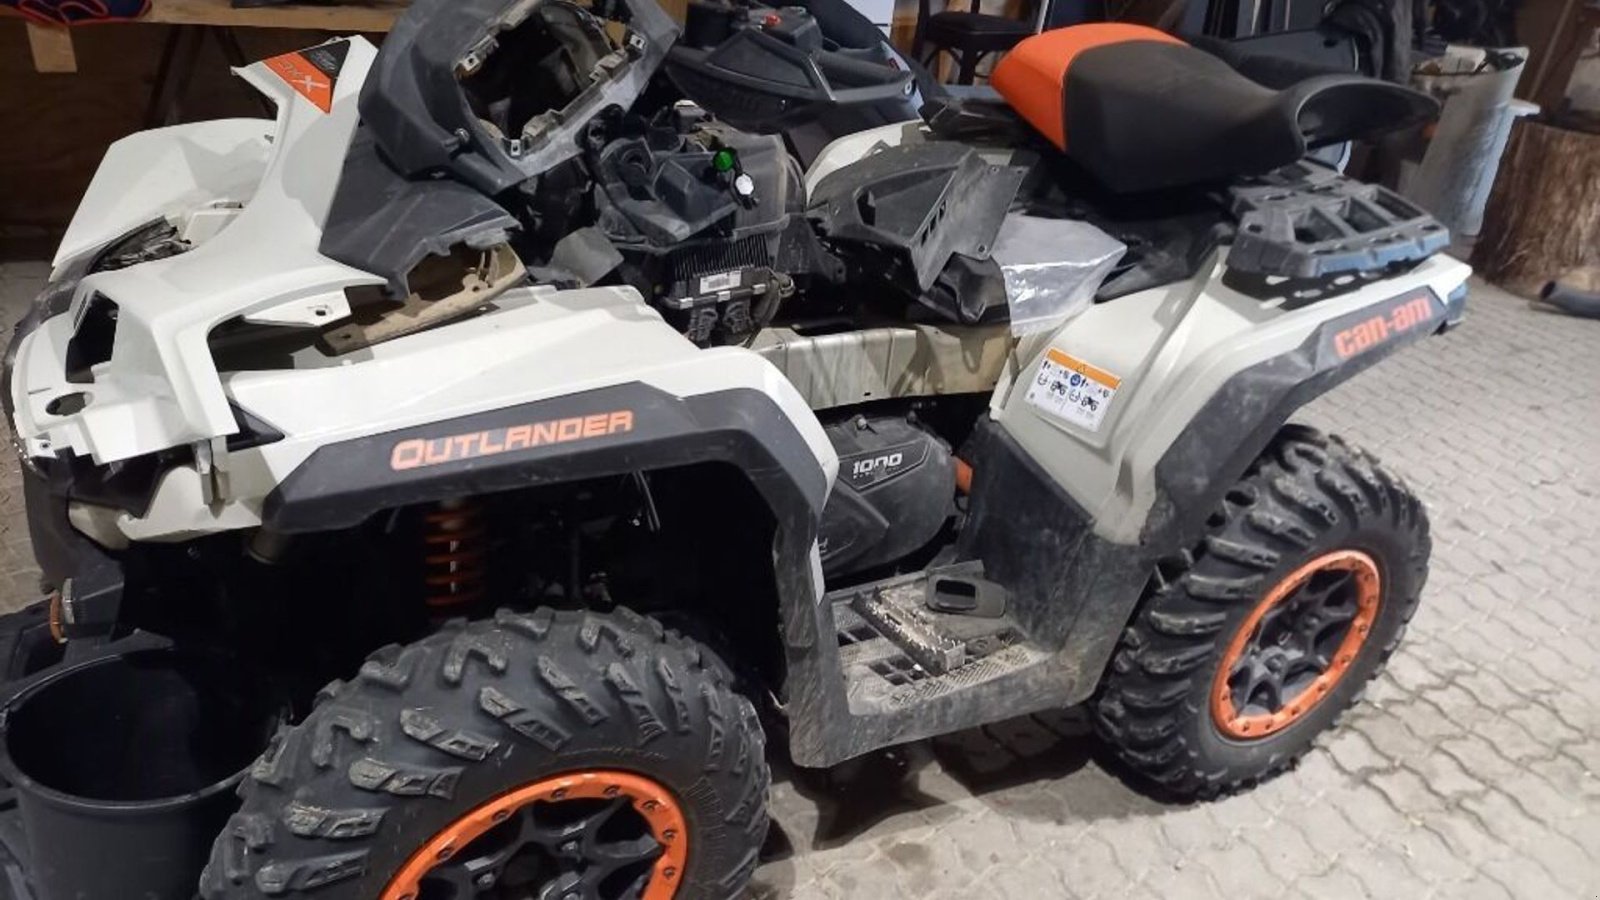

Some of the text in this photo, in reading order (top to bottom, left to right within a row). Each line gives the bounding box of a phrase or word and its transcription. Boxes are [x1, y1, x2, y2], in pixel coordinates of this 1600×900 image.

[1334, 296, 1431, 358] can-am
[391, 410, 634, 470] OUTLANDER
[853, 452, 903, 474] 1000
